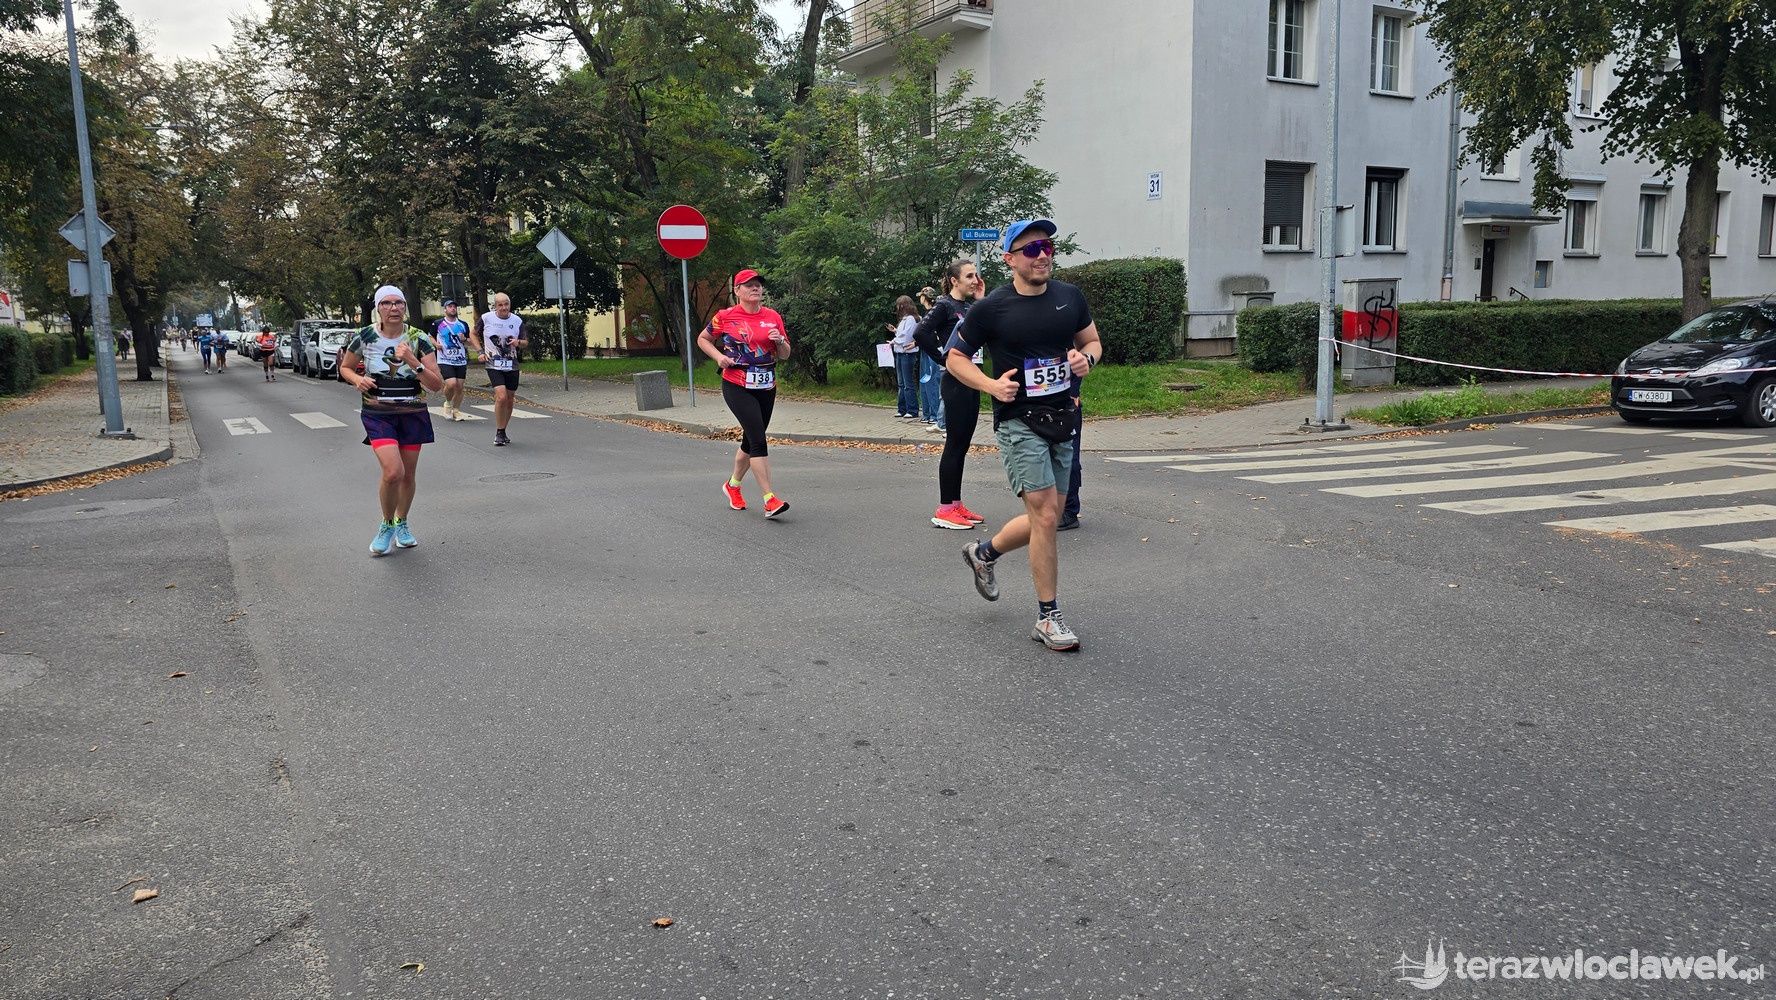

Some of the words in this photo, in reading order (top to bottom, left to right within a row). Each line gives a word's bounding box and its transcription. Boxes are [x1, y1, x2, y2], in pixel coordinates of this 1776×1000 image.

[1149, 179, 1160, 193] 31
[751, 373, 770, 383] 138
[1033, 364, 1067, 385] 555
